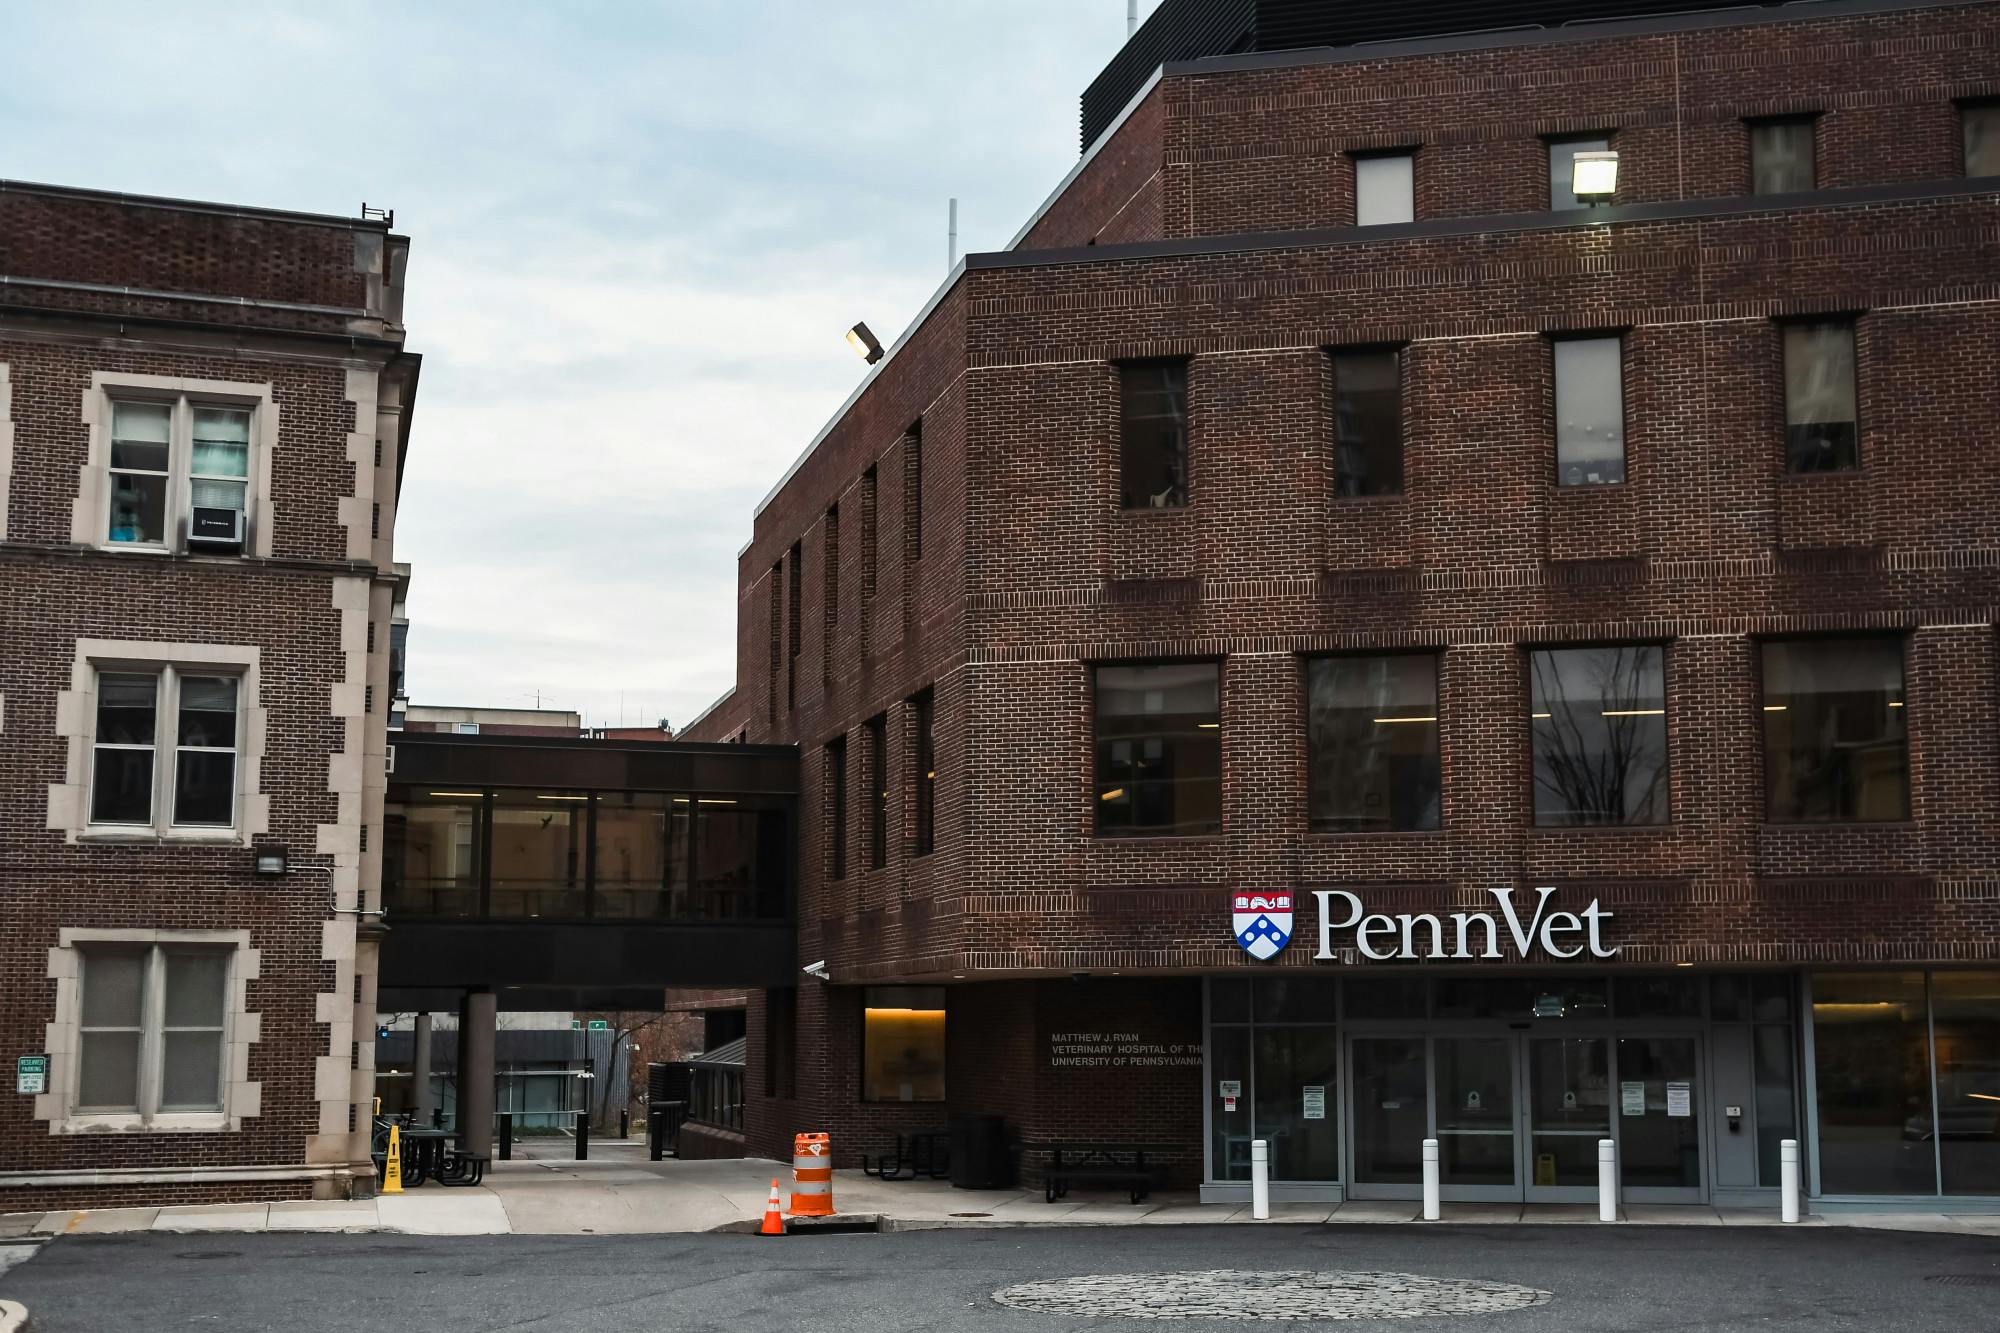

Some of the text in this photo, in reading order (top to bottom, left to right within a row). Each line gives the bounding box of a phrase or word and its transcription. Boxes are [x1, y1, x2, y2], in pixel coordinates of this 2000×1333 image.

[1312, 887, 1617, 960] PennVet
[1051, 1033, 1101, 1042] MATTHEW
[1113, 1033, 1139, 1042] RYAN
[1052, 1045, 1203, 1054] VETERINARY HOSPITAL OF TH
[1052, 1056, 1203, 1066] UNIVERSITY OF PENNSYLVANIA
